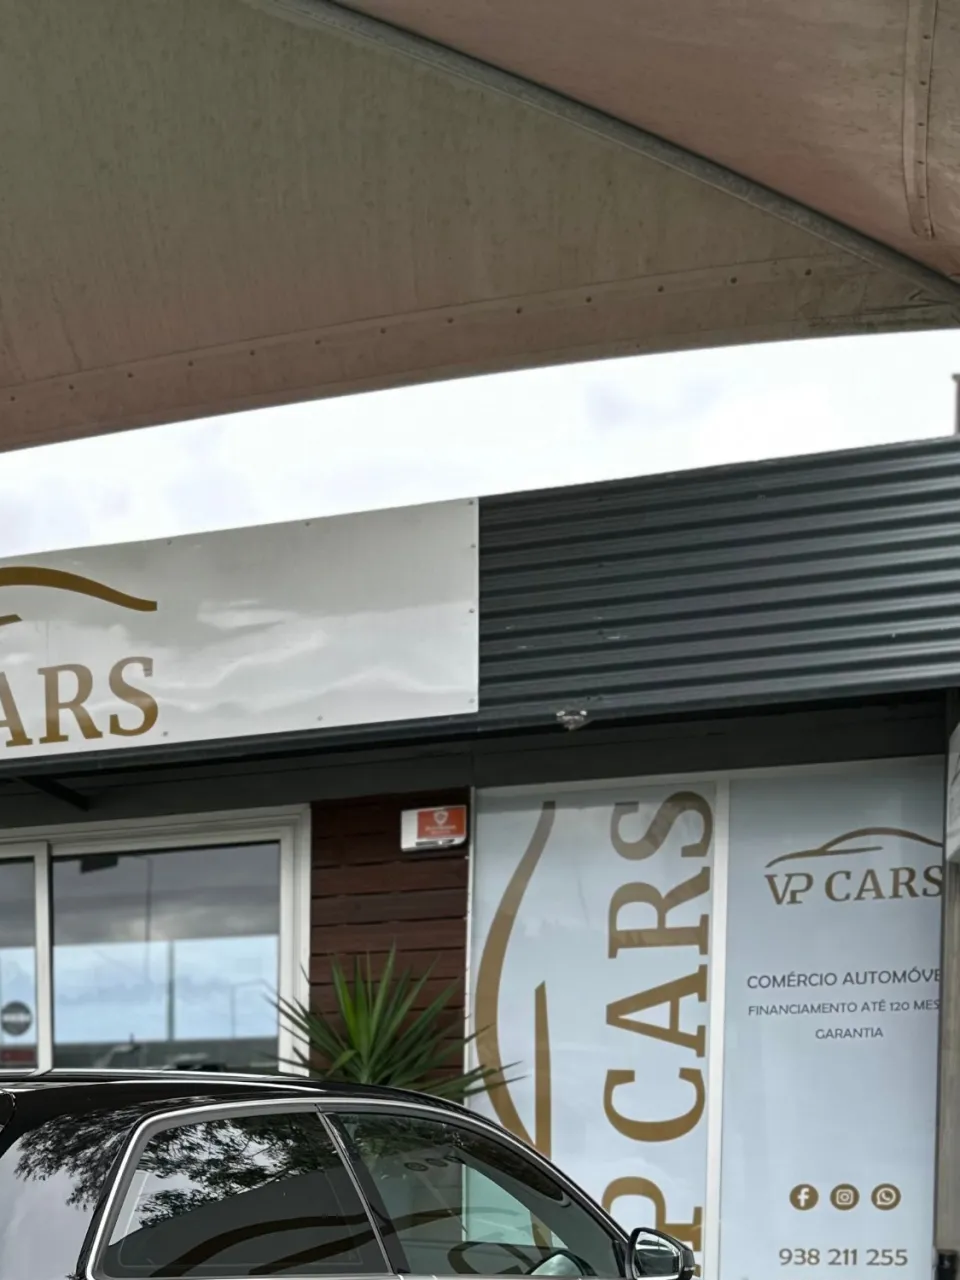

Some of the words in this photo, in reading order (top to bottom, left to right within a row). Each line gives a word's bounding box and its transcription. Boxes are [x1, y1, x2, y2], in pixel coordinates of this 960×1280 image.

[764, 872, 814, 905] VP
[824, 865, 944, 902] CARS
[603, 791, 713, 1142] CARS
[746, 970, 838, 989] COMÉRCIO
[748, 1002, 858, 1016] FINANCIAMENTO
[861, 998, 886, 1013] ATÉ
[890, 1001, 910, 1012] 120
[815, 1026, 884, 1040] GARANTIA
[778, 1248, 821, 1266] 938
[827, 1248, 858, 1266] 211
[865, 1248, 909, 1267] 255
